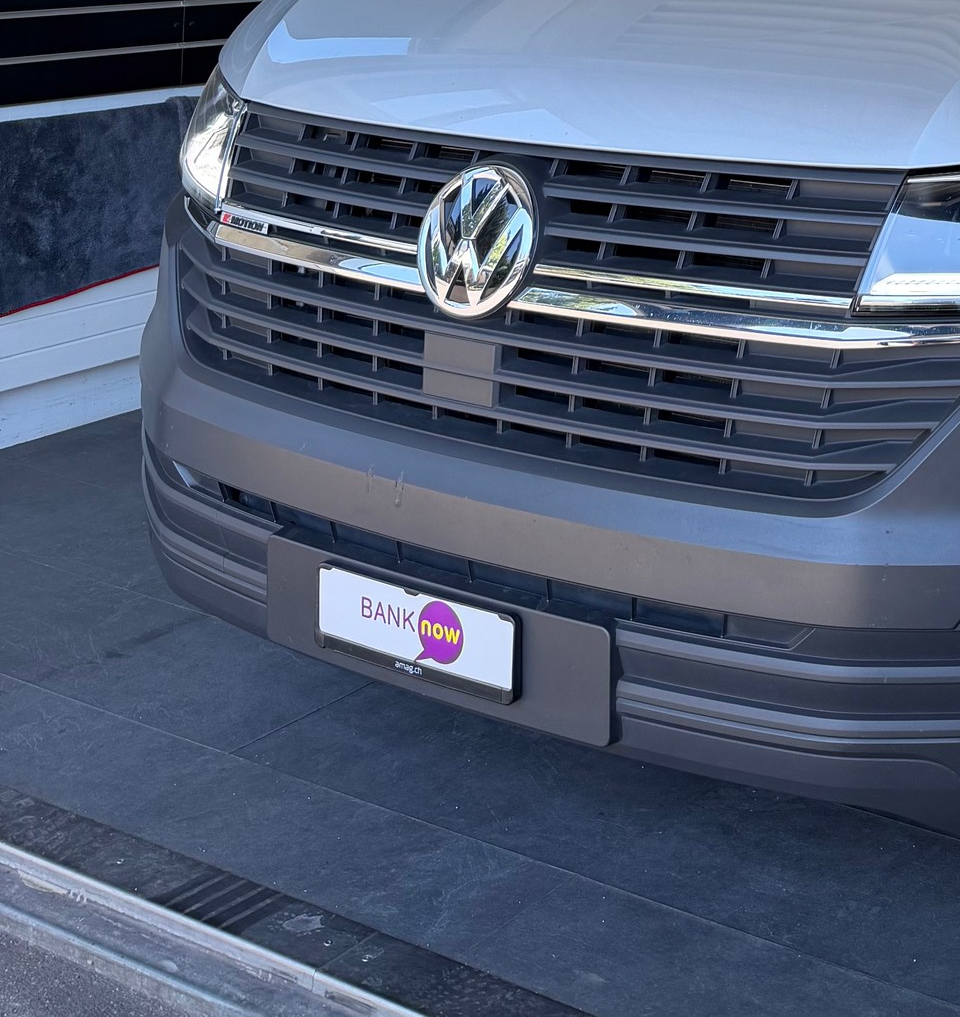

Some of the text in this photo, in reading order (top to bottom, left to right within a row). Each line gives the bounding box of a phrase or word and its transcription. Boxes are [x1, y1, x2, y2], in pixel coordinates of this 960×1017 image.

[361, 596, 460, 645] BANK now
[394, 660, 423, 675] amag.ch
